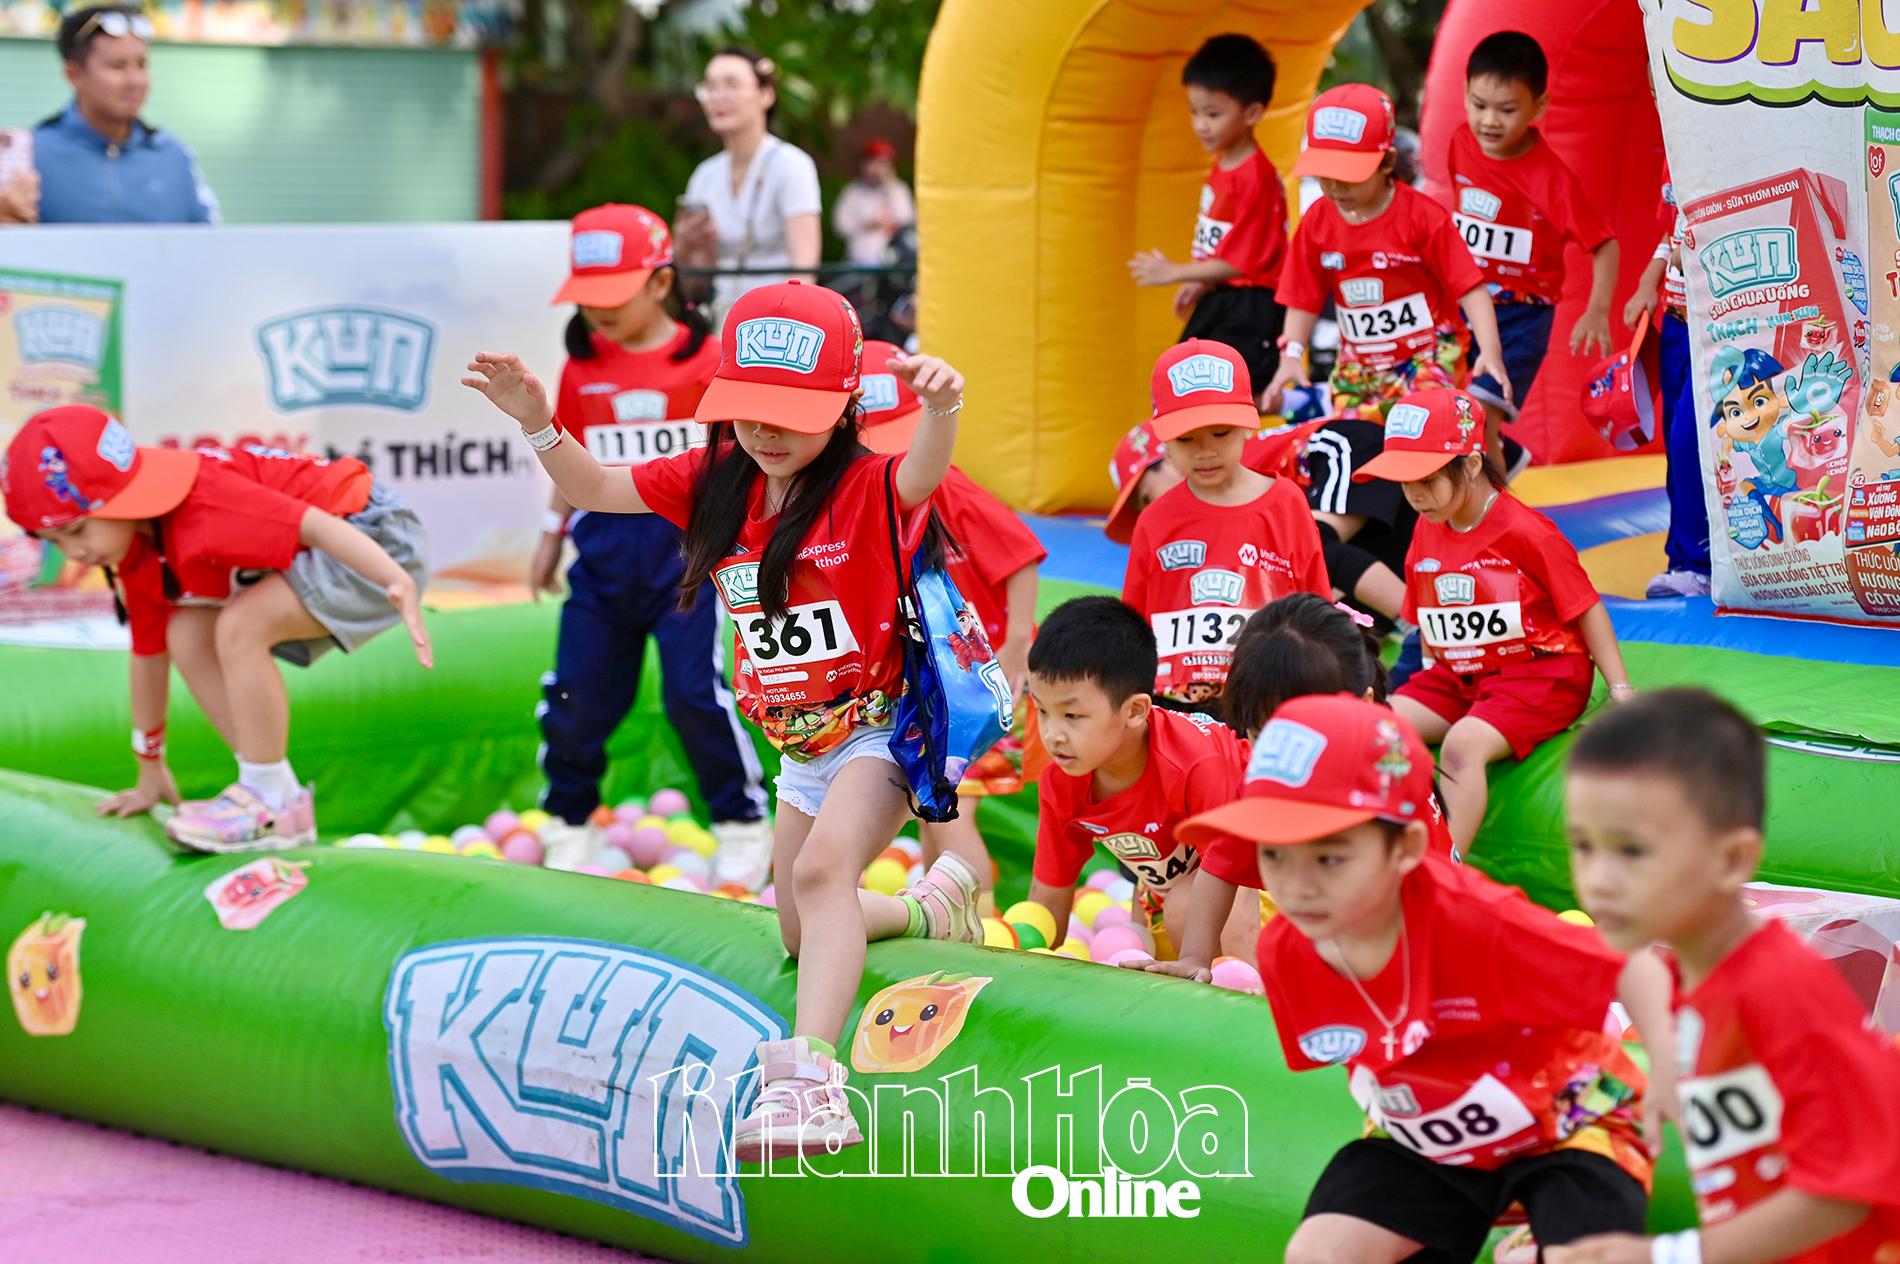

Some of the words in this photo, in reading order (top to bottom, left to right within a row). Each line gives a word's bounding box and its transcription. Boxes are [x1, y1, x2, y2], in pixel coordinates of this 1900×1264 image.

[1744, 189, 1771, 204] THƠM
[1771, 180, 1800, 196] NGON
[1767, 283, 1811, 303] UỐNG
[389, 432, 511, 477] THÍCH
[797, 540, 846, 560] nExpress
[1854, 551, 1883, 568] THỨC
[1758, 570, 1784, 587] CHUA
[1783, 564, 1810, 583] UỐNG
[1866, 588, 1885, 605] CÓ
[1427, 609, 1508, 640] 11396
